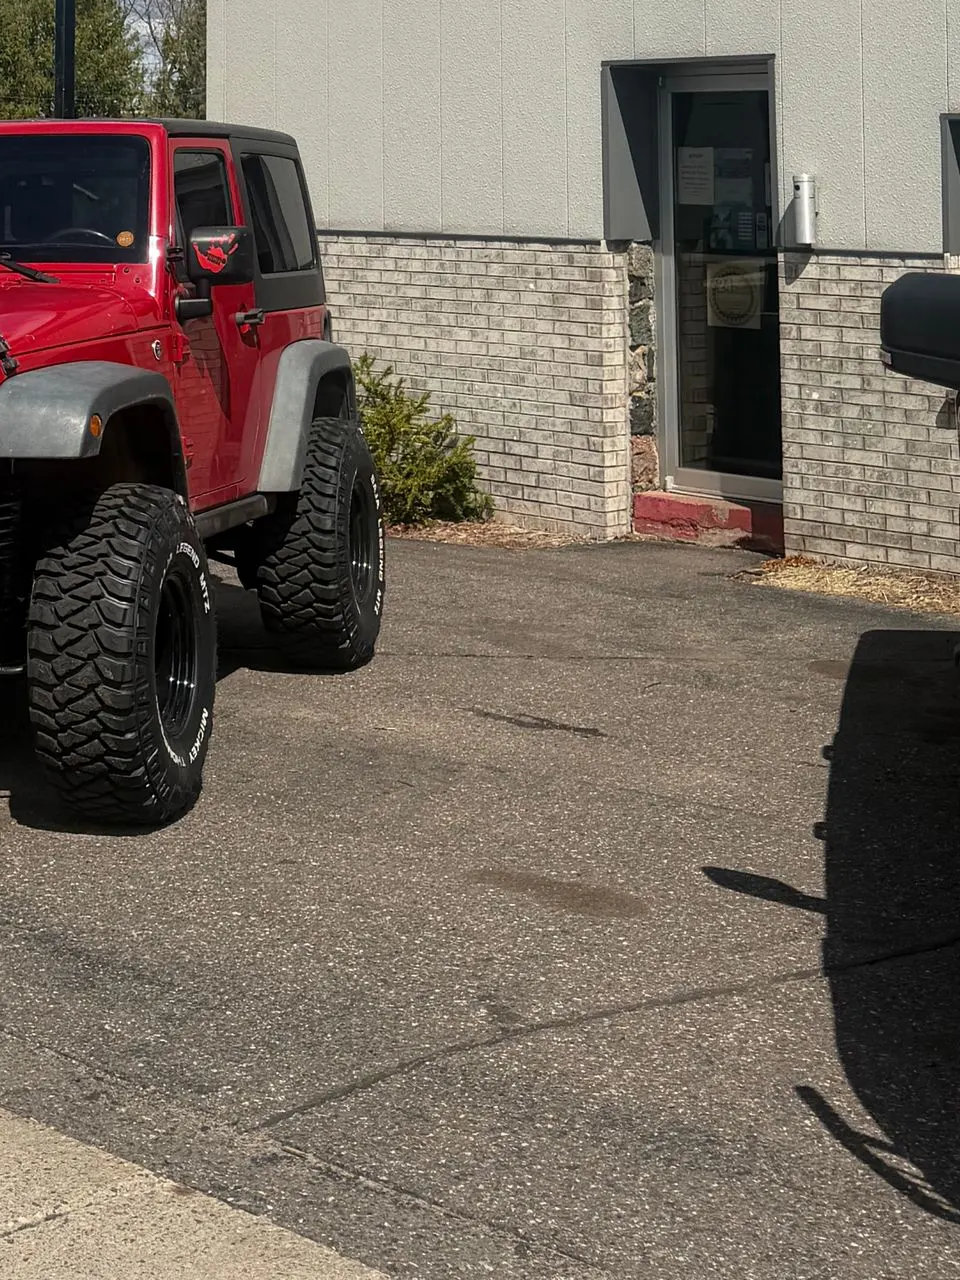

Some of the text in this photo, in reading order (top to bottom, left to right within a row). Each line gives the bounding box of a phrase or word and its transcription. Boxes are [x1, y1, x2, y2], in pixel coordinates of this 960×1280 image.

[176, 542, 210, 614] LEGEND MTZ
[189, 707, 208, 764] MICKEY
